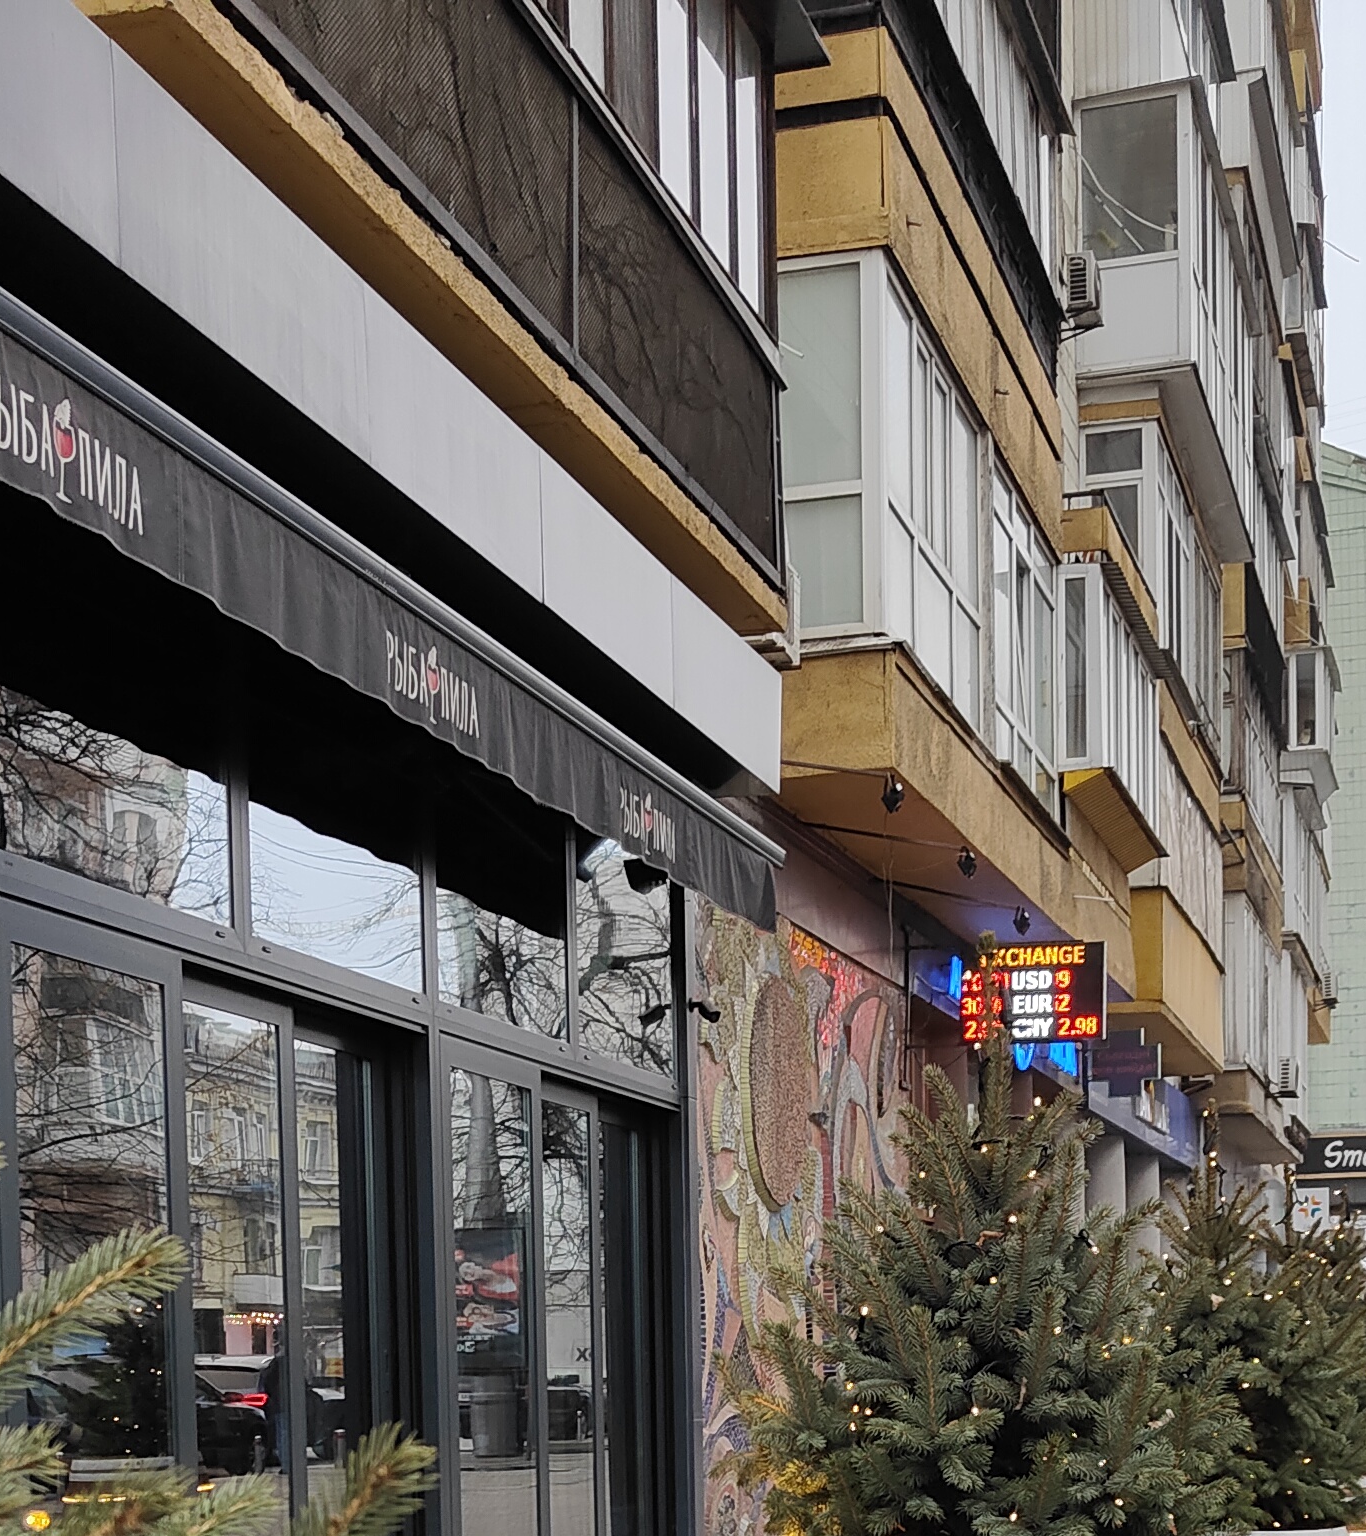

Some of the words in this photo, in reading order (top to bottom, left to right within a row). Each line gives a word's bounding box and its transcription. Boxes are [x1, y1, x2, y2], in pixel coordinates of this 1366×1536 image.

[78, 427, 144, 536] ПИЛА
[386, 629, 429, 708] РЫБА
[440, 665, 480, 739] ПИЛА
[1011, 970, 1053, 990] USD
[1012, 993, 1053, 1014] EUR
